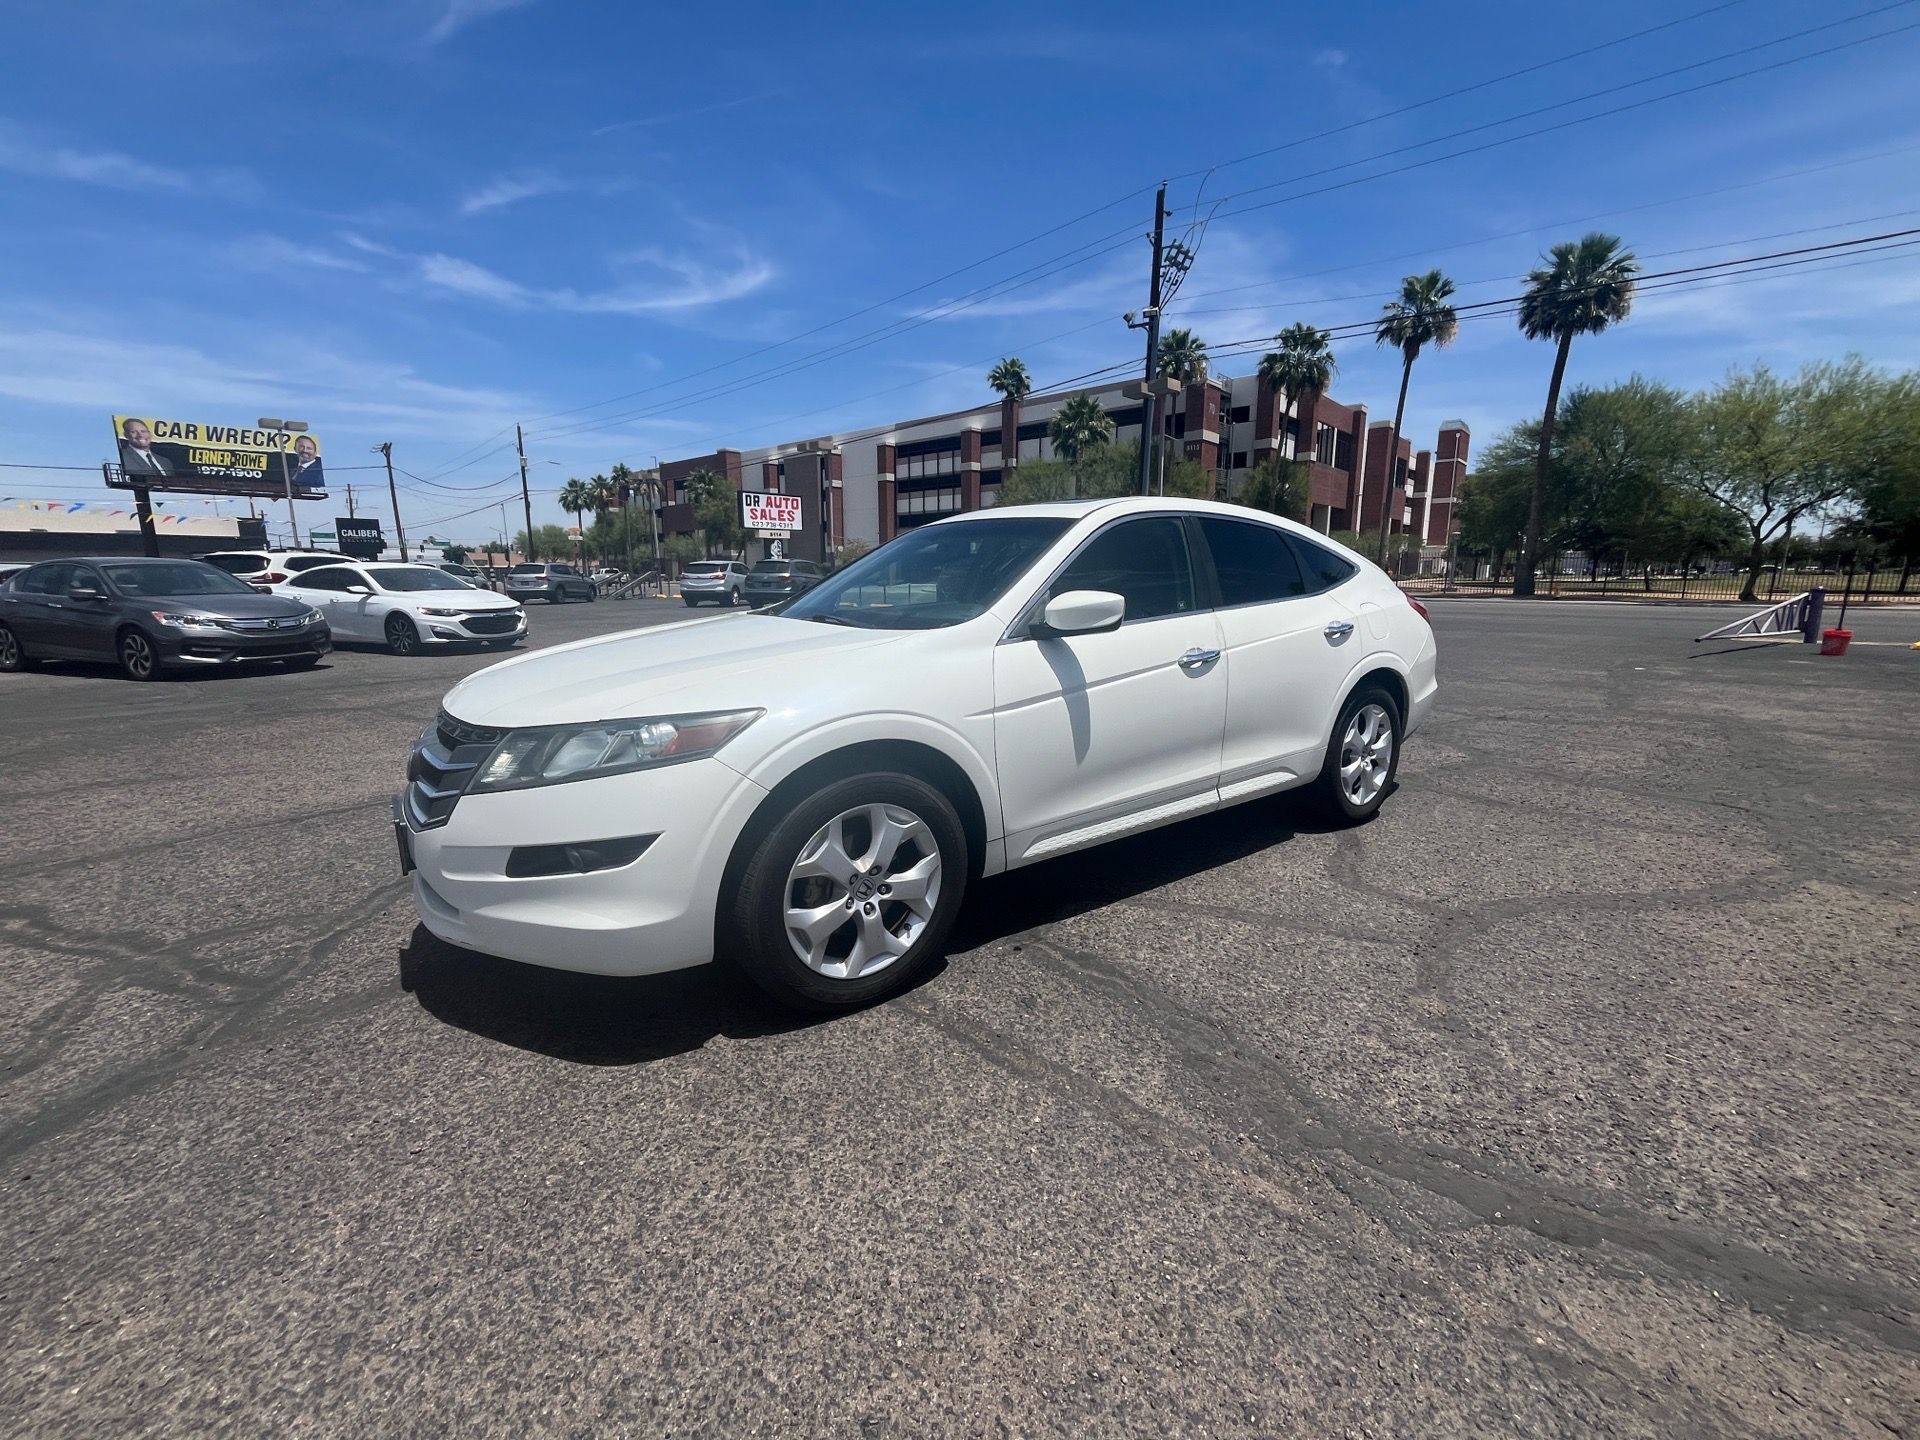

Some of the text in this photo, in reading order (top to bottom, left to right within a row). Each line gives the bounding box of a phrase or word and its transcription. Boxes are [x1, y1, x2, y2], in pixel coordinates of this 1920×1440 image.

[154, 420, 291, 450] CAR WRECK?
[189, 449, 231, 466] LERNER
[235, 453, 264, 469] ROWE
[745, 494, 799, 510] DR AUTO
[750, 508, 795, 522] SALES
[341, 529, 378, 538] CALIBER
